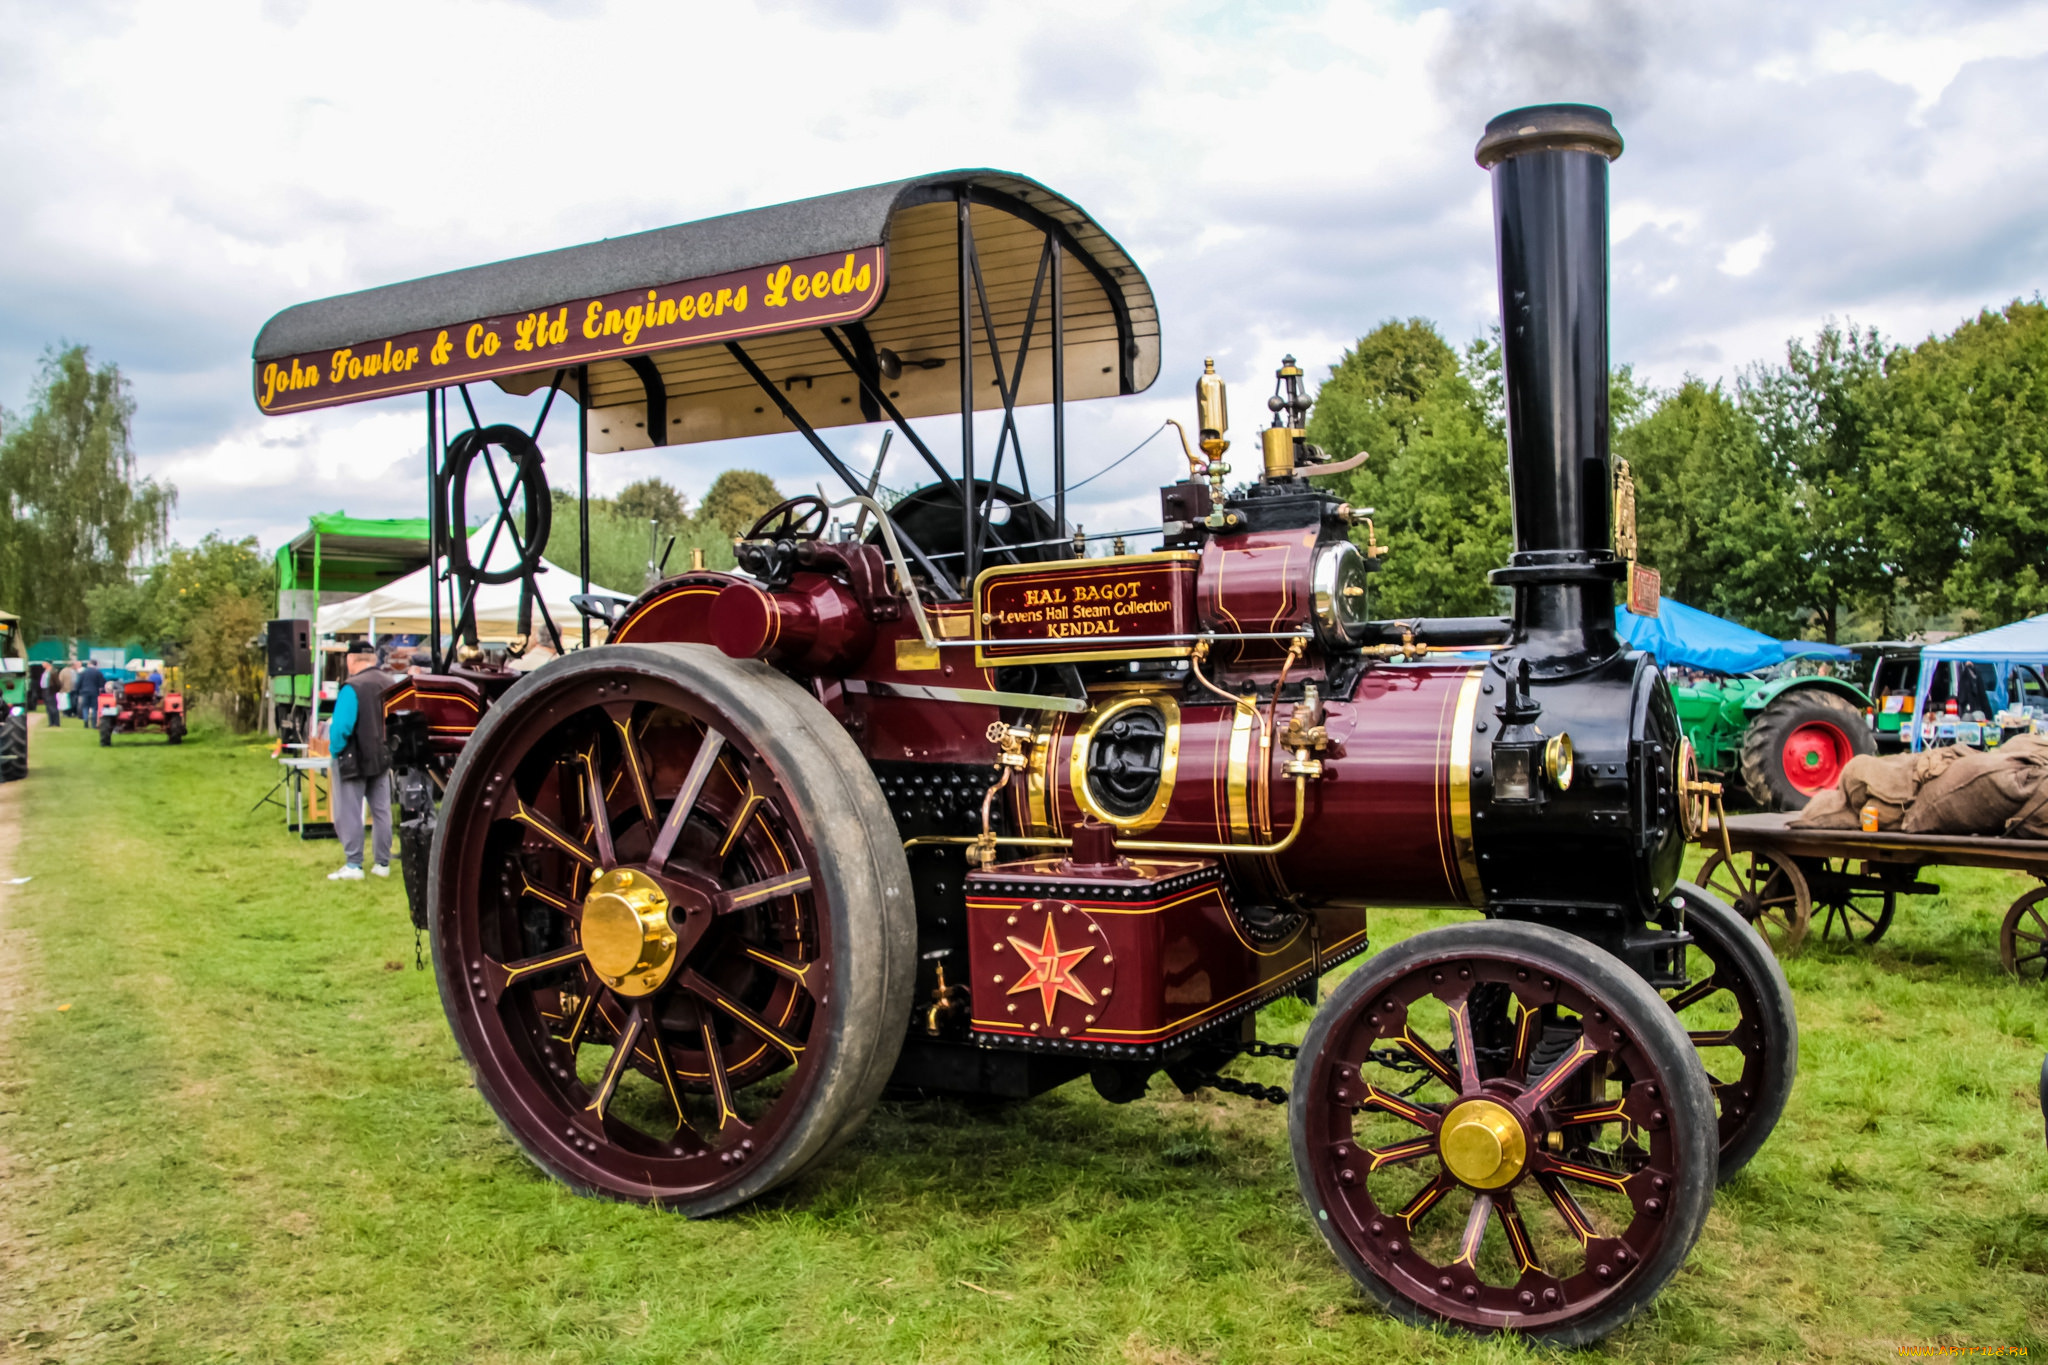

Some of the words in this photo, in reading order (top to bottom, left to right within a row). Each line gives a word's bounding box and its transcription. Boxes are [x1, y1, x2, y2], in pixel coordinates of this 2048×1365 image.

[260, 358, 320, 407] John
[330, 340, 419, 384] Fowler
[430, 330, 453, 366] &
[465, 323, 501, 360] Co
[513, 307, 569, 351] Ltd
[582, 289, 748, 345] Engineers
[764, 253, 871, 307] Leeds
[1024, 588, 1067, 607] HAL
[1072, 581, 1142, 603] BAGOT
[1000, 609, 1043, 624] Levens
[1045, 605, 1069, 621] Hall
[1073, 604, 1111, 619] Steam
[1113, 599, 1172, 616] Collection
[1047, 619, 1120, 639] KENDAL
